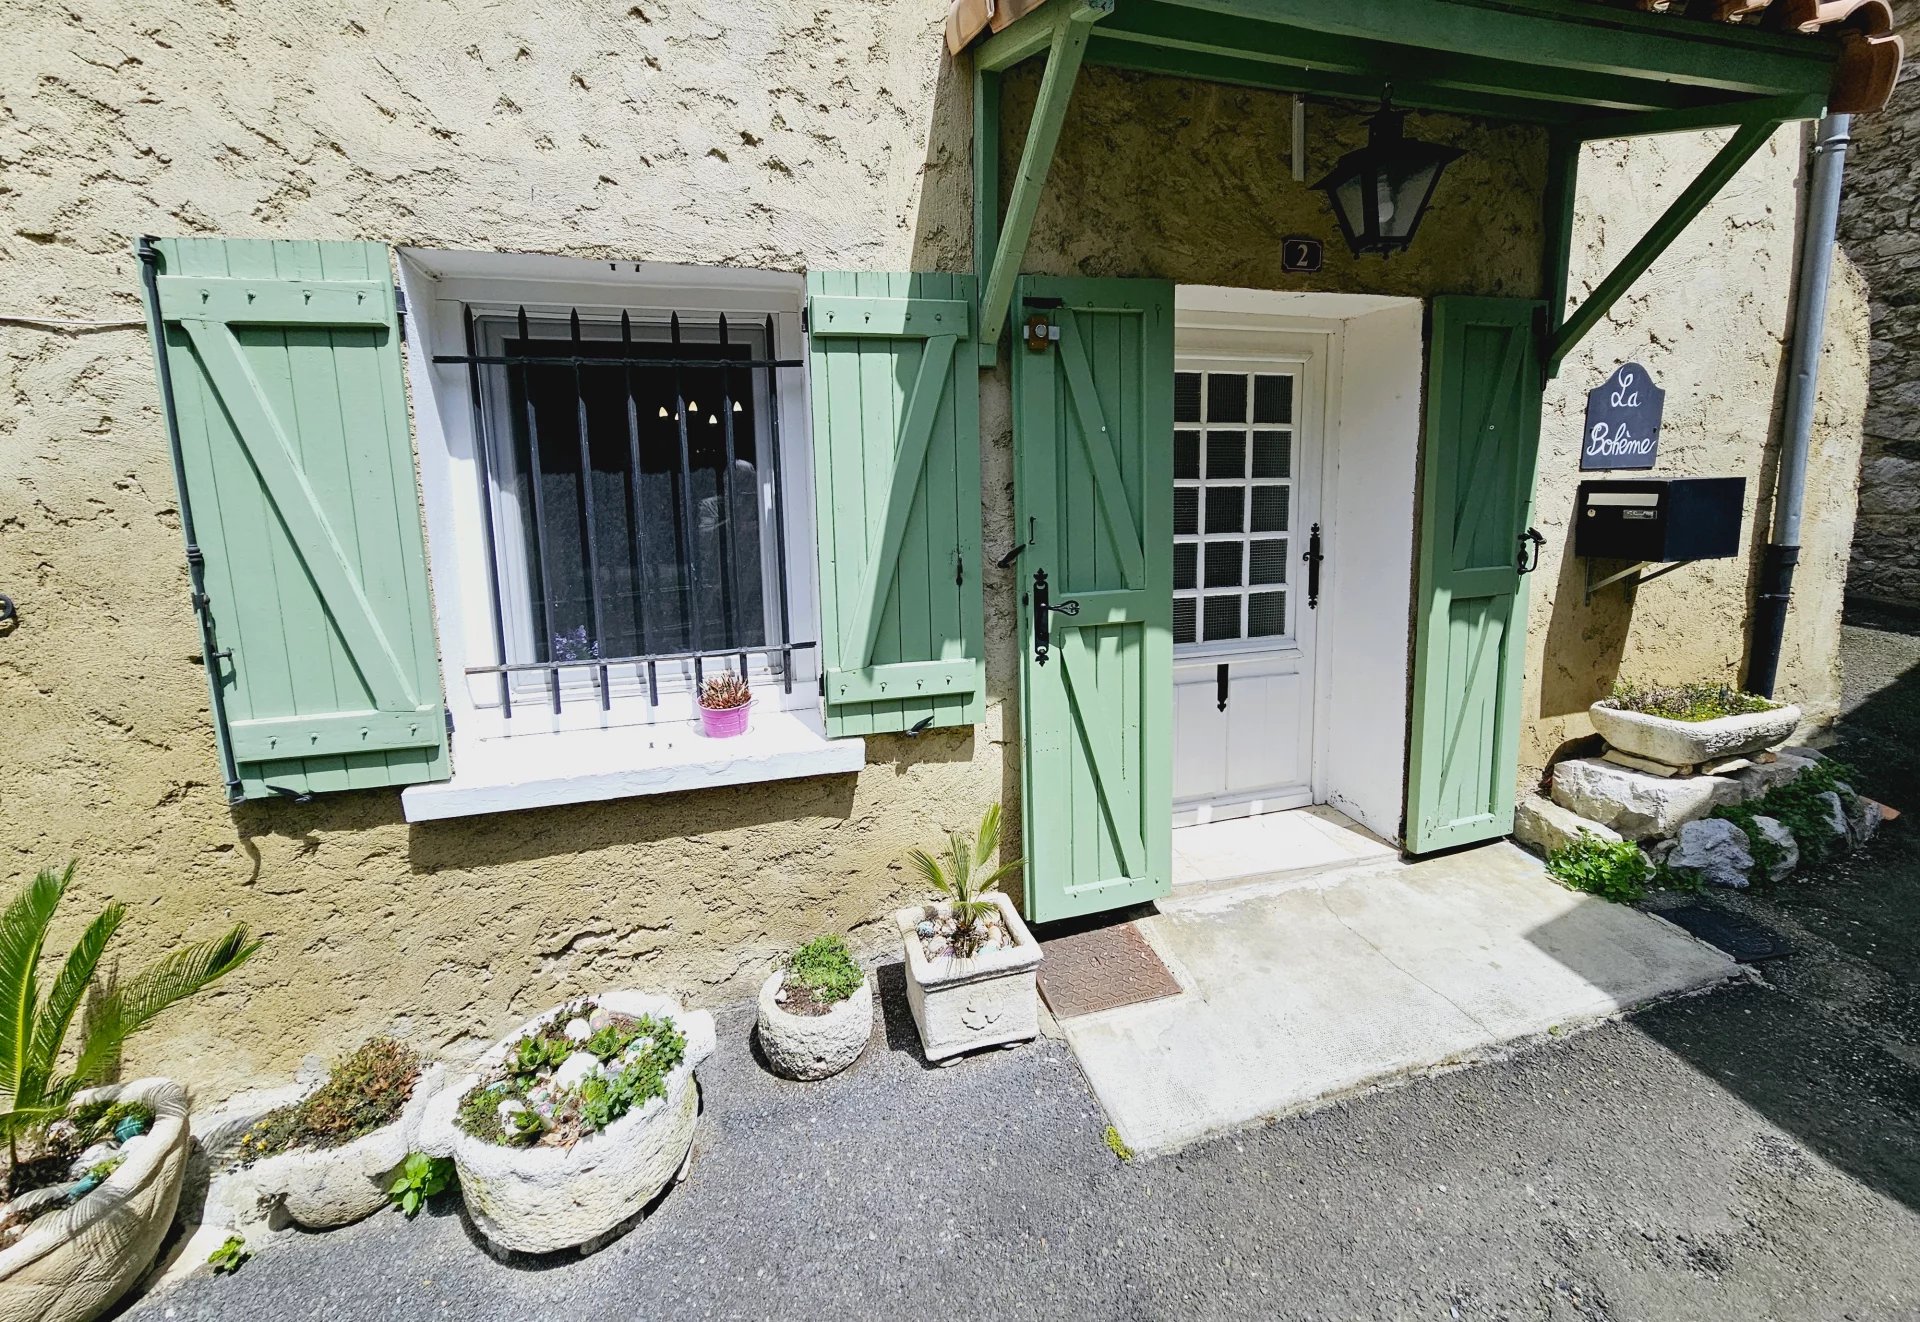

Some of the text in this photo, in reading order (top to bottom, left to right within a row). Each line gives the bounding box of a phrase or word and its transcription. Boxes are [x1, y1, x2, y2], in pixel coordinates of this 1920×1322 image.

[1296, 244, 1308, 267] 2
[1610, 367, 1642, 407] La
[1586, 422, 1656, 456] Bohème
